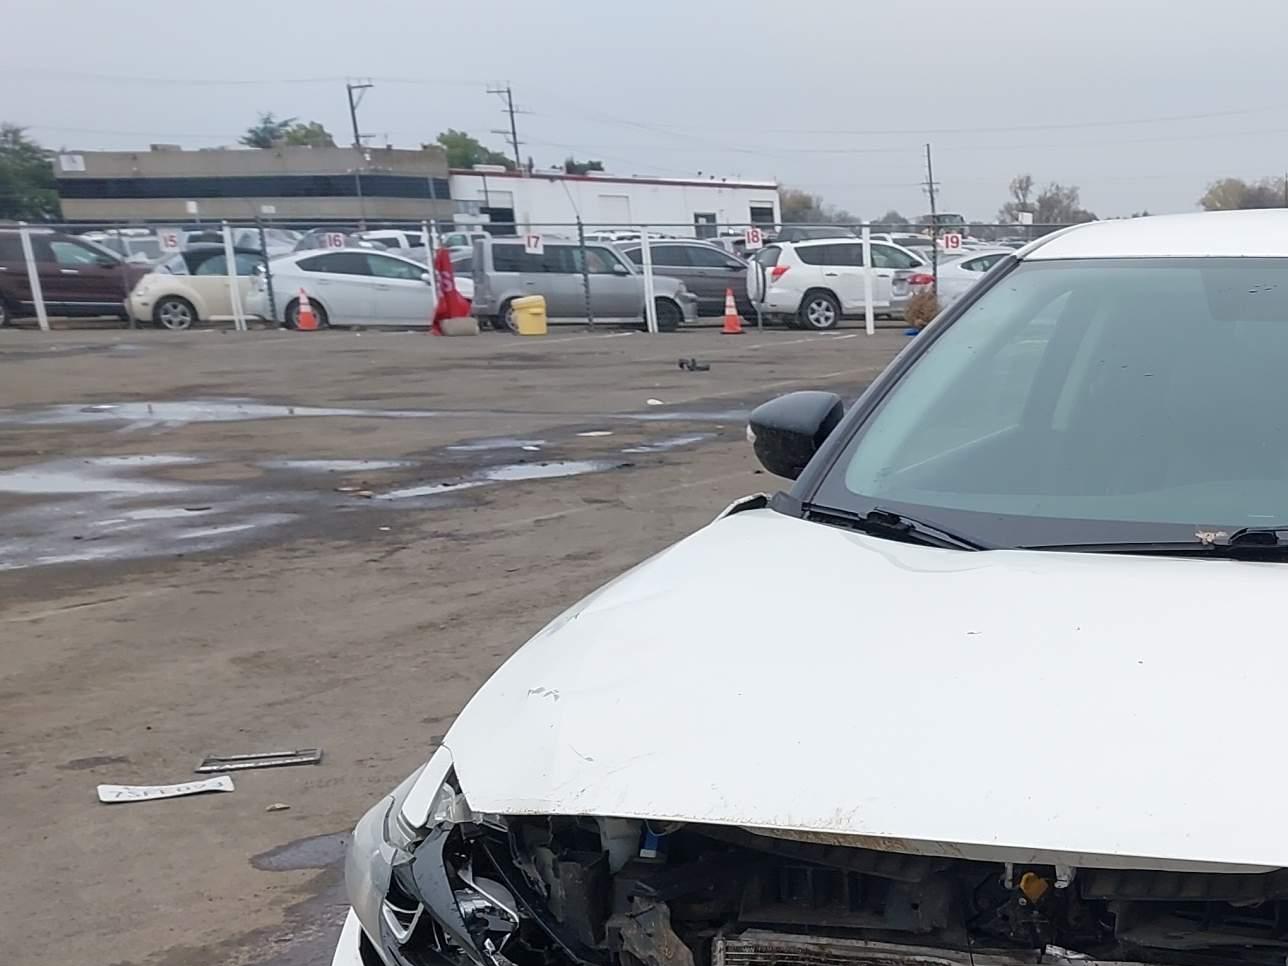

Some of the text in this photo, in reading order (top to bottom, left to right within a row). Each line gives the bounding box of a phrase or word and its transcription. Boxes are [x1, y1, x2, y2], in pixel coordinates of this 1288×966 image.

[163, 235, 177, 247] 15
[327, 234, 342, 247] 16
[527, 235, 540, 248] 17
[746, 230, 760, 244] 18
[945, 235, 960, 249] 19
